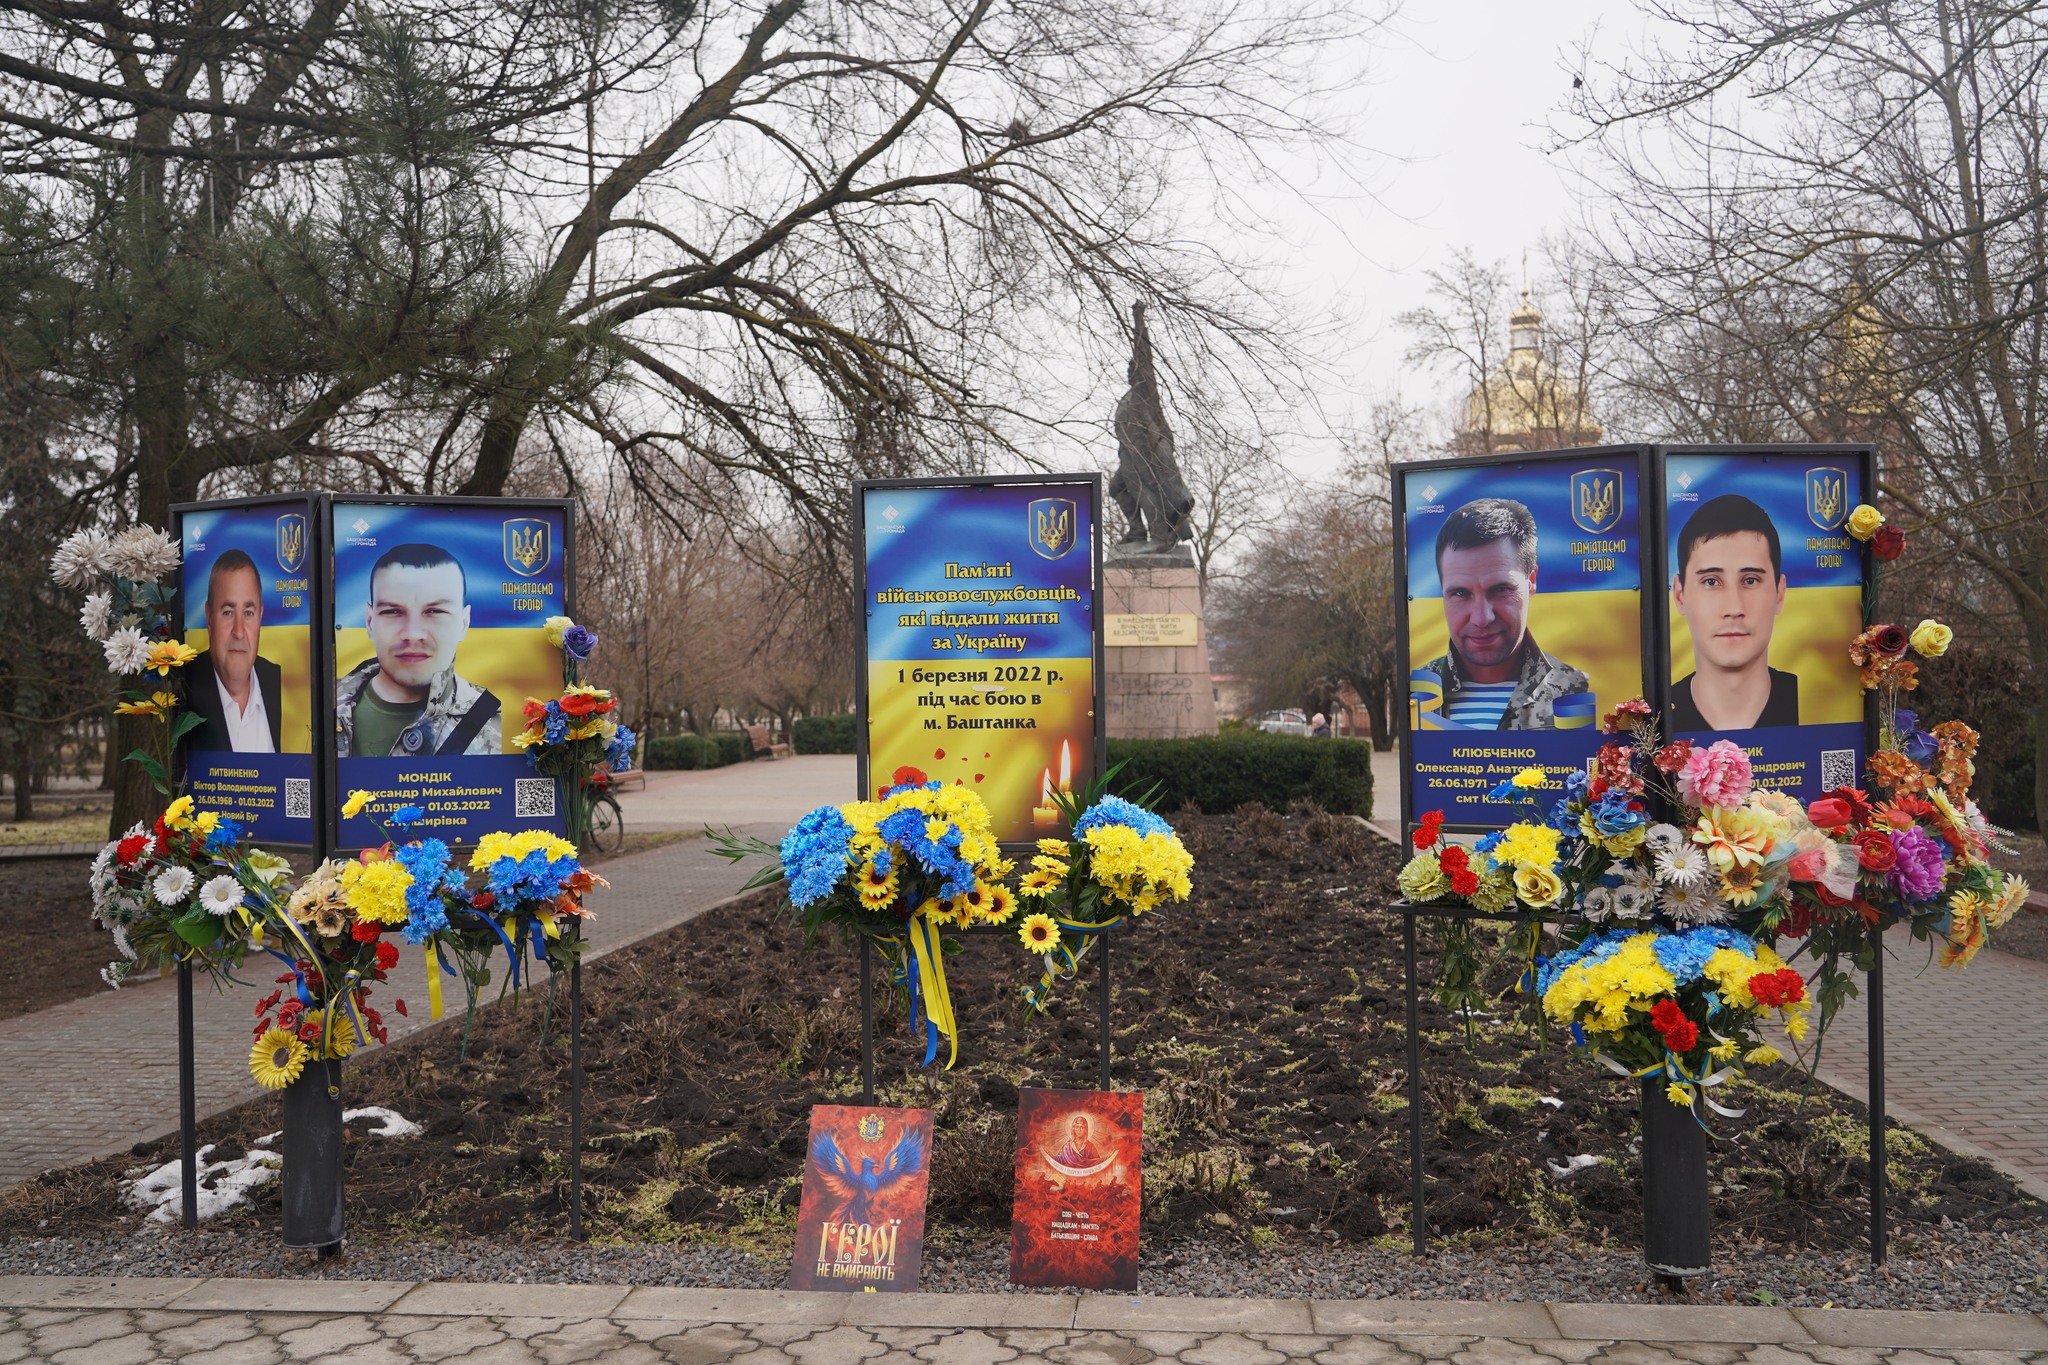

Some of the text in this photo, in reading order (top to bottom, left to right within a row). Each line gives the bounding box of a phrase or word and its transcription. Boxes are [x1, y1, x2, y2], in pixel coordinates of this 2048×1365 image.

[1570, 539, 1626, 555] ПАМ'ЯТАЄМО
[1806, 536, 1850, 551] ПАМ'ЯТАЄМО
[945, 561, 1012, 579] Пам'яті
[1582, 557, 1615, 572] ГЕРОЇВ!
[502, 582, 554, 596] ПАМ'ЯТАЄМО
[876, 585, 1081, 606] військовослужбовців,
[513, 598, 543, 611] ГЕРОЇВ!
[898, 610, 1060, 628] які віддали життя
[932, 633, 1027, 653] за Україну
[898, 666, 1064, 686] 1 березня 2022 р.
[917, 691, 1042, 708] під час бою в
[924, 714, 1036, 730] м. Баштанка
[1453, 748, 1536, 758] КЛЮБЧЕНКО
[209, 767, 259, 778] ЛИТВИНЕНКО
[1415, 763, 1484, 775] Олександр
[398, 772, 452, 783] МОНДІК
[1428, 778, 1487, 788] 26.06.1971
[193, 781, 277, 794] Віктор Володимирович
[347, 787, 503, 800] ександр Михайлович
[198, 795, 233, 805] 26.06.1968
[238, 798, 275, 807] 01.03.2022
[1456, 795, 1535, 804] смт Казака
[364, 803, 416, 813] 1.01.19
[428, 801, 490, 811] 01.03.2022
[246, 812, 259, 822] Буг
[383, 816, 467, 828] с. ширівка
[818, 1219, 901, 1265] ГЕРОЇ
[816, 1262, 895, 1280] НЕ ВМИРАЮТЬ
